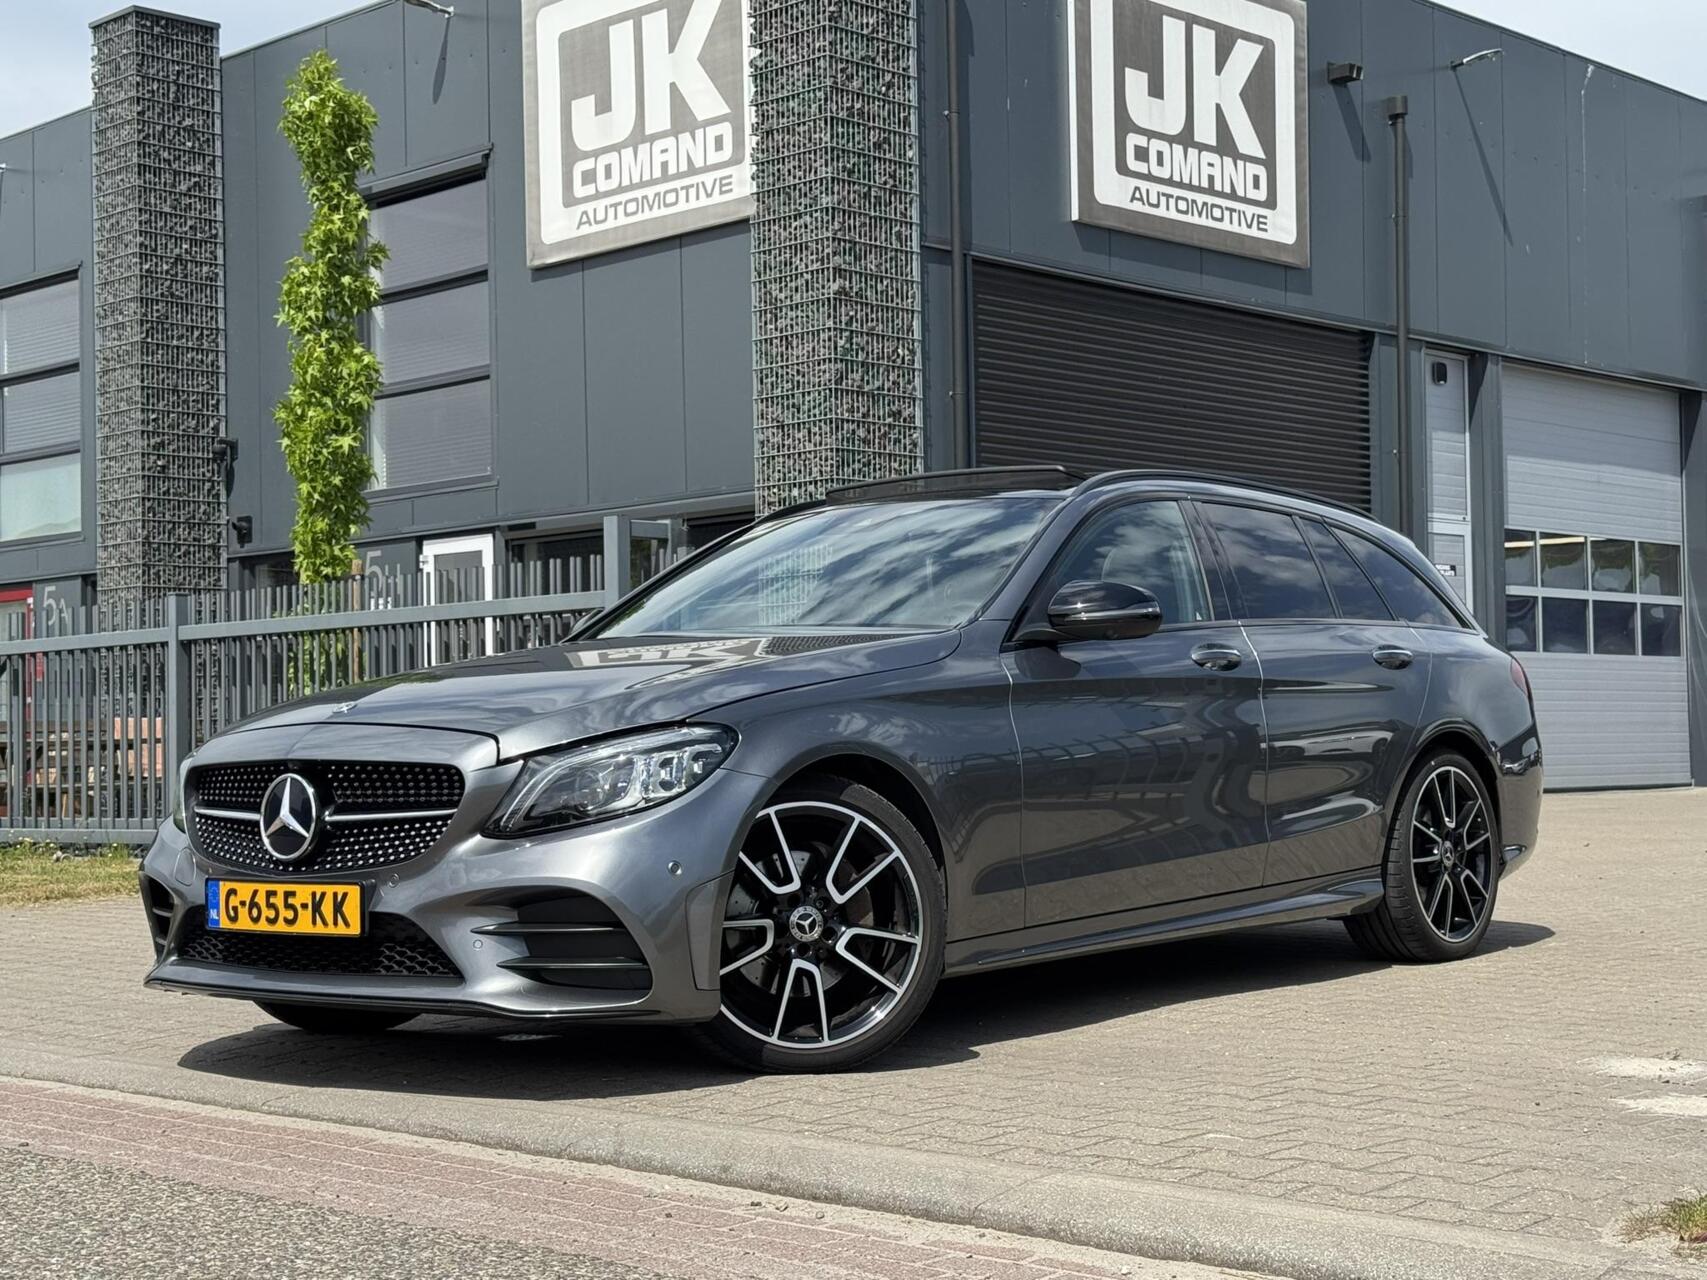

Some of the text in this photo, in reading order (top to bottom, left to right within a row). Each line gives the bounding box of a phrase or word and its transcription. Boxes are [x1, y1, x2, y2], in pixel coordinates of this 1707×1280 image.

[571, 0, 732, 151] JK
[1125, 14, 1266, 159] JK
[572, 121, 733, 199] COMAND
[1125, 132, 1268, 202] COMAND
[575, 174, 734, 230] AUTOMOTIVE
[1129, 186, 1269, 232] AUTOMOTIVE
[43, 585, 68, 625] 5A
[209, 909, 219, 919] NL
[224, 887, 351, 929] G-655-KK
